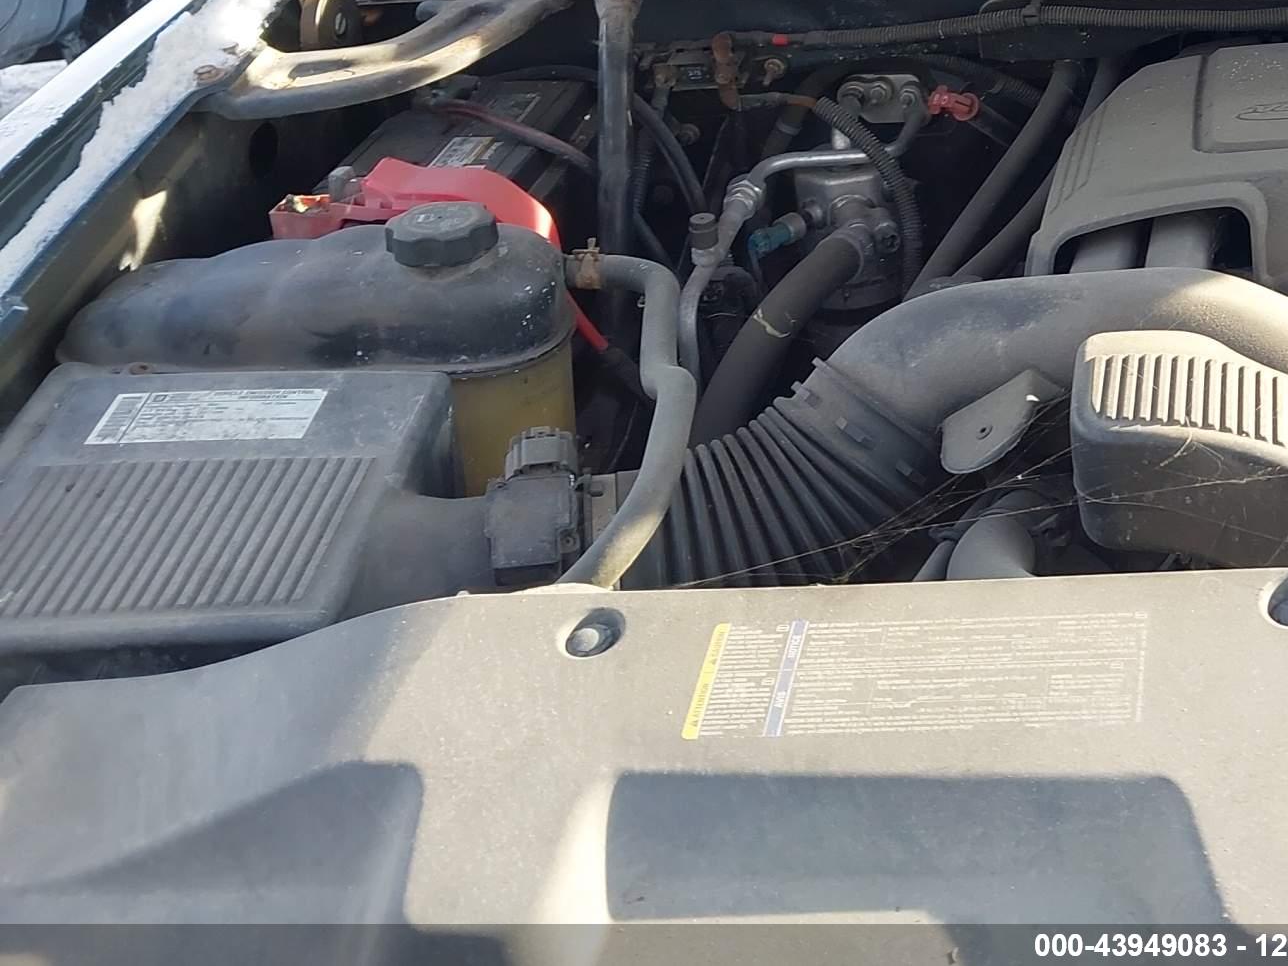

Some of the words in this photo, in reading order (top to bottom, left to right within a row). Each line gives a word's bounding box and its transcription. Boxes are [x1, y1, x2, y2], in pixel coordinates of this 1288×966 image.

[788, 635, 802, 658] NOTICE
[694, 682, 709, 718] ATTENTION
[773, 690, 786, 709] AVIS
